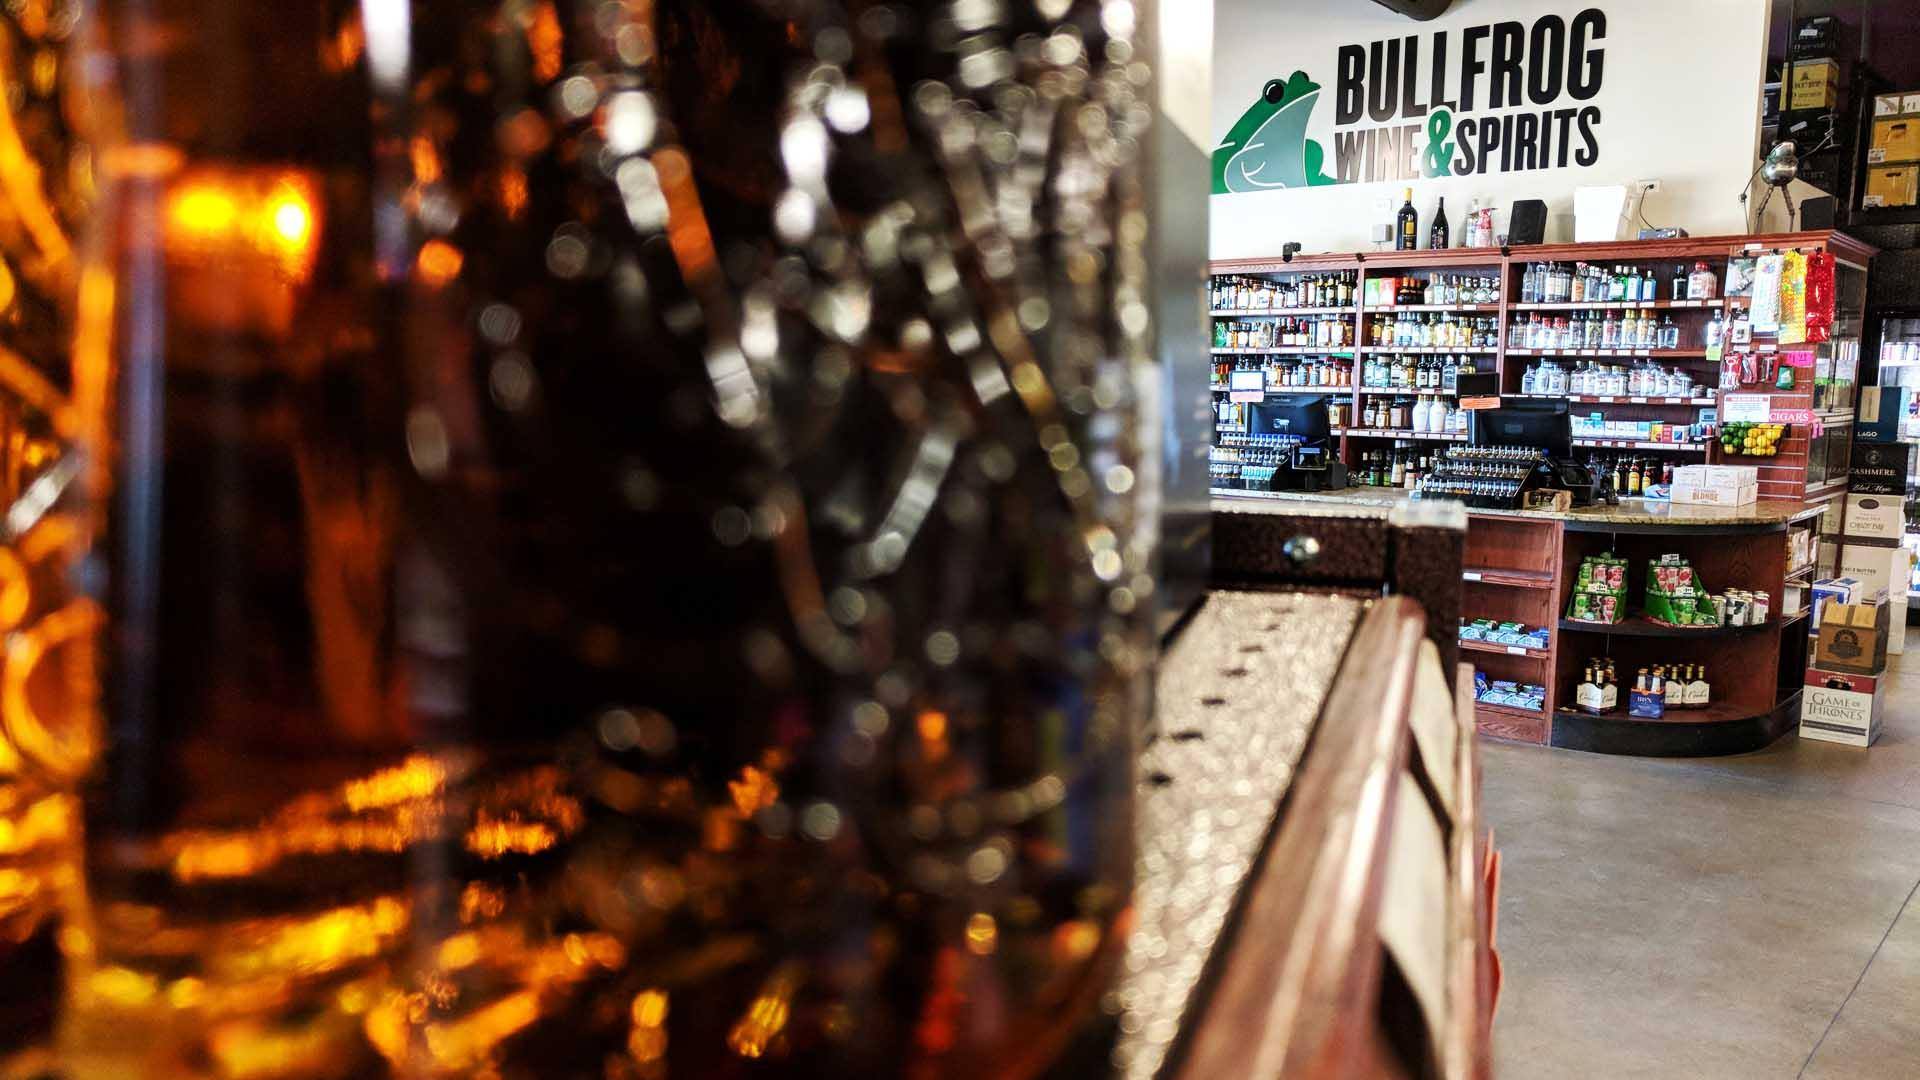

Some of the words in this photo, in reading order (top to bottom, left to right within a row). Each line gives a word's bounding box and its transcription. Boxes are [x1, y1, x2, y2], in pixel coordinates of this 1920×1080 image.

[1335, 8, 1607, 126] BULLFROG
[1453, 105, 1602, 176] SPIRITS
[1769, 412, 1809, 423] CIGARS
[1849, 467, 1897, 477] CASHMERE
[1812, 692, 1850, 707] GAME
[1806, 703, 1862, 720] THRONES
